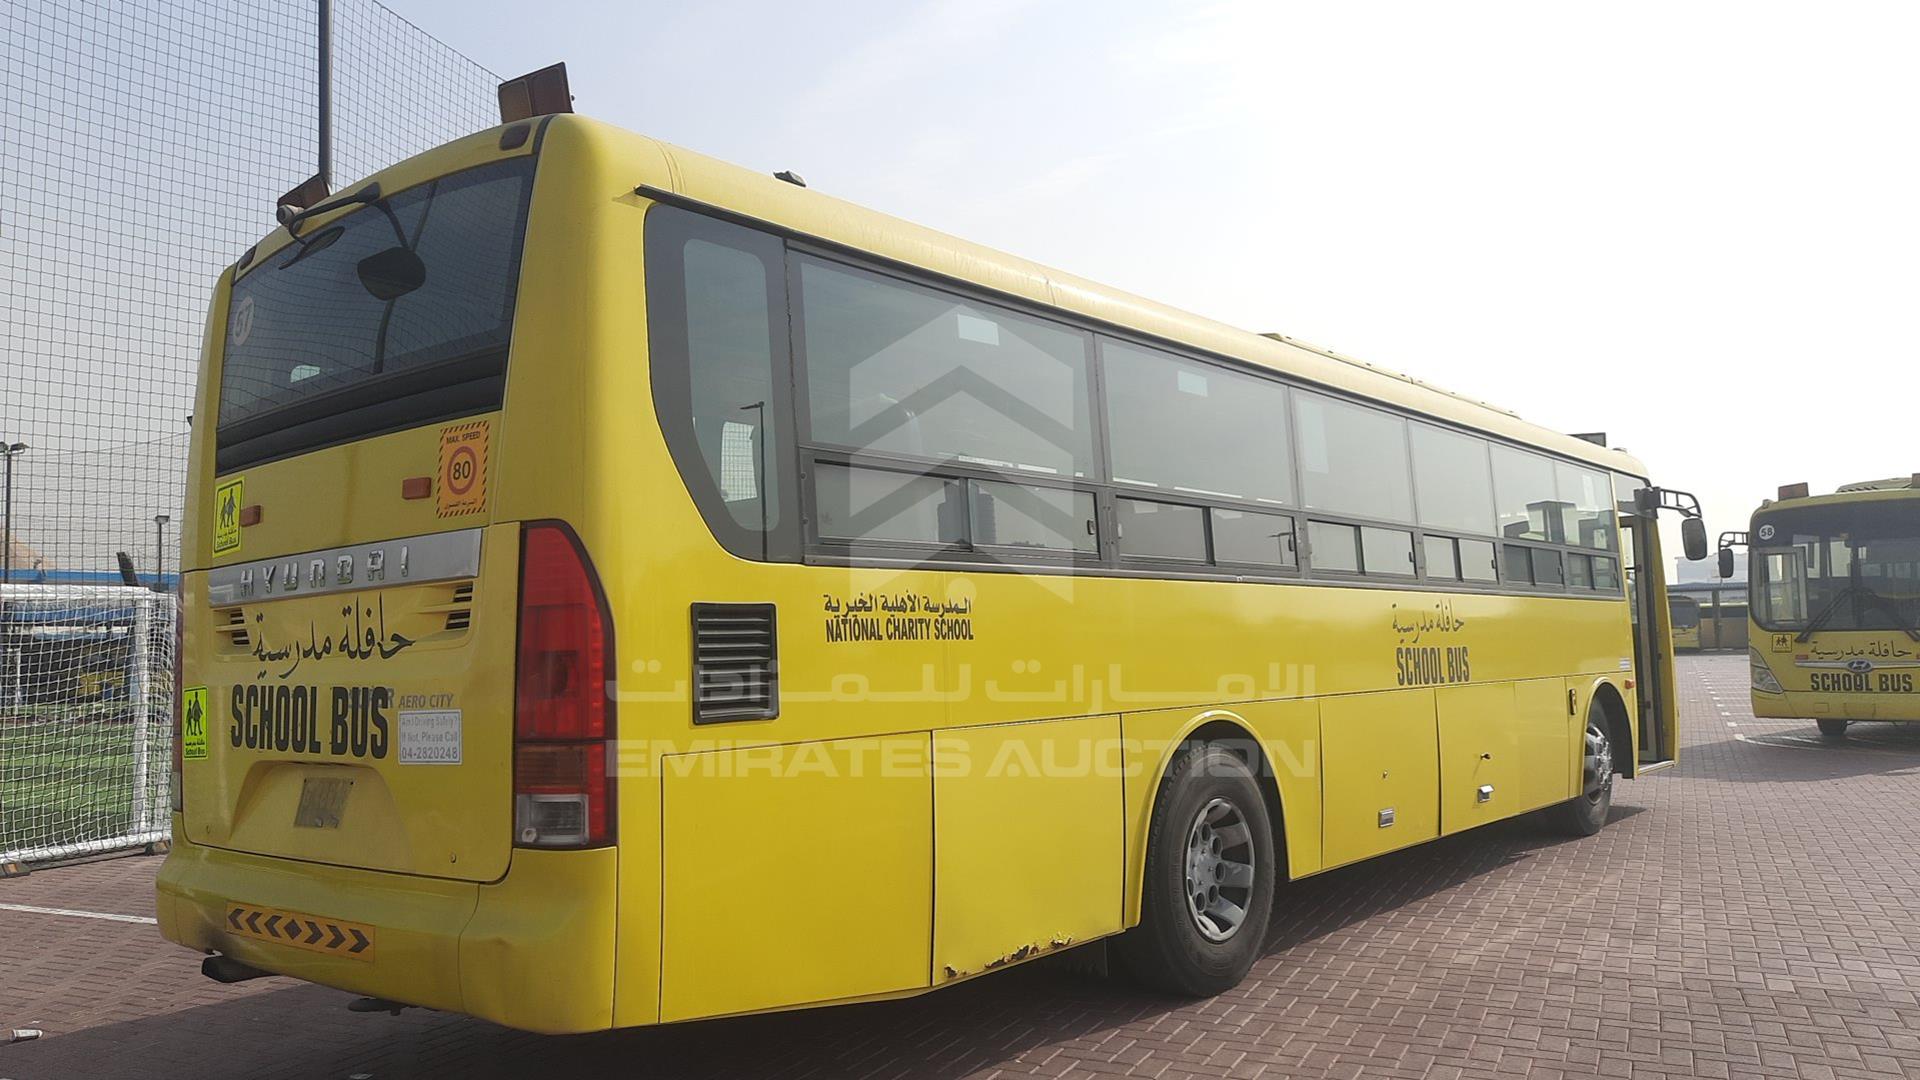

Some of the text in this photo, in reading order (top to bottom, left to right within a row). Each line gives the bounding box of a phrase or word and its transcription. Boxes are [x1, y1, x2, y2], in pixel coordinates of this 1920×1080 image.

[462, 430, 480, 441] SPEED
[453, 460, 471, 480] 80
[1761, 527, 1773, 537] 58
[240, 546, 408, 597] HYUNDAI
[823, 592, 878, 619] الخيرية
[923, 594, 972, 618] المدرسة
[825, 617, 974, 642] NATIONAL CHARITY SCHOOL
[1391, 599, 1465, 644] حافلة مدرسية
[252, 592, 416, 679] حافلة مدرسية
[1810, 640, 1912, 660] حافلة مدرسية
[1396, 646, 1470, 686] SCHOOL BUS
[1810, 672, 1913, 692] SCHOOL BUS
[399, 696, 425, 708] AERO
[429, 694, 454, 707] CITY
[231, 684, 388, 759] SCHOOL BUS
[421, 731, 443, 742] Please
[444, 730, 458, 742] Call
[401, 746, 458, 760] 04-2820248
